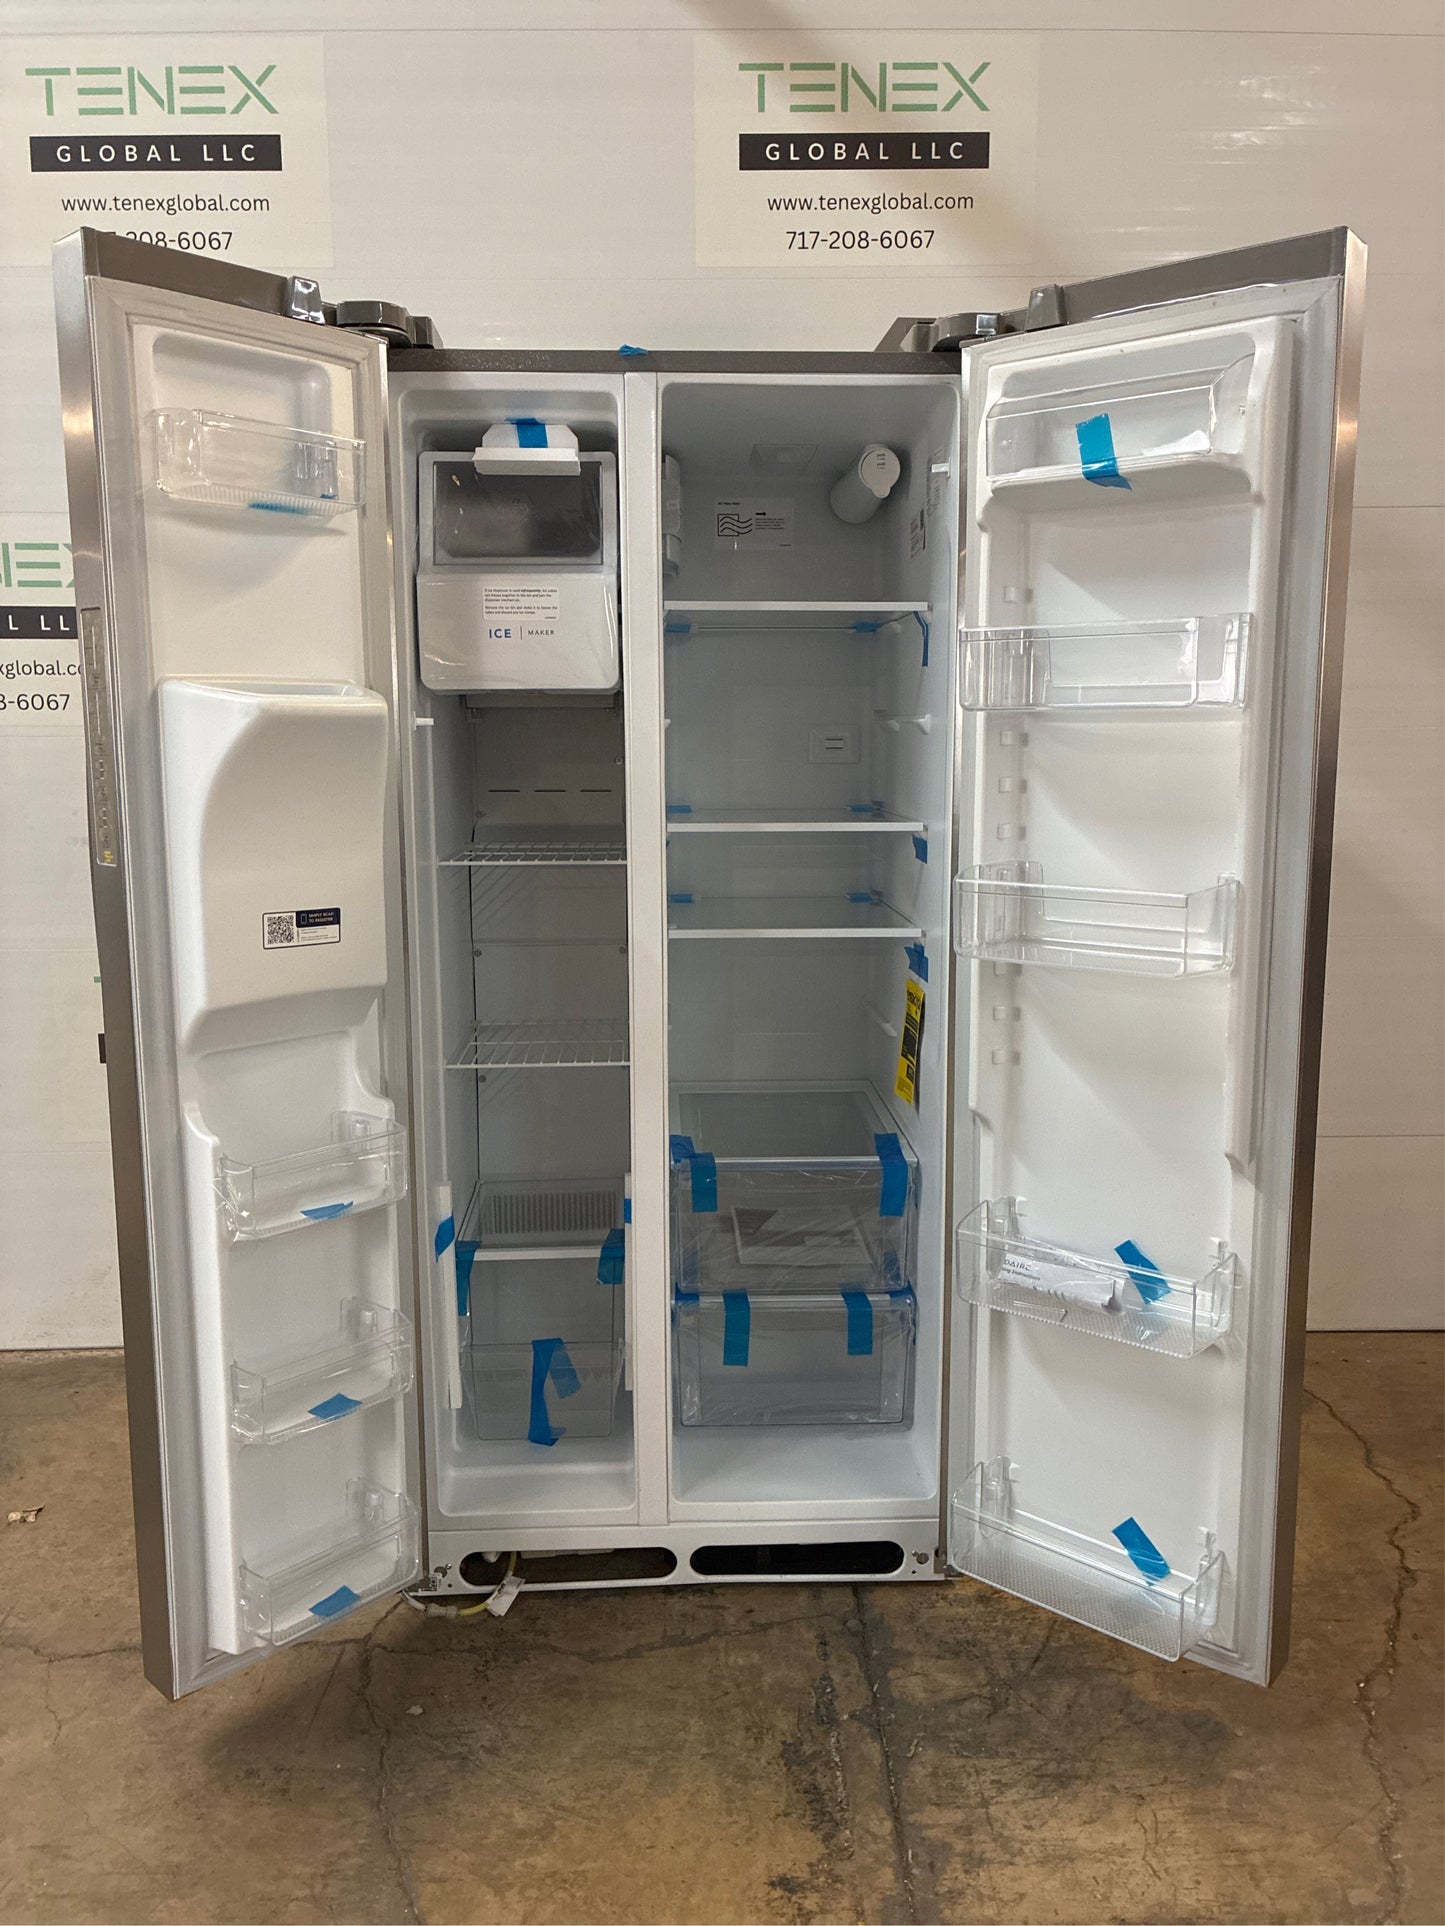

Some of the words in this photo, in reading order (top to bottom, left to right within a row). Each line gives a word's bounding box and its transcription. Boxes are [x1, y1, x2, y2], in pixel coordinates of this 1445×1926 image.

[25, 65, 279, 115] TENEX
[739, 62, 991, 113] TENEX
[56, 145, 181, 162] GLOBAL
[203, 144, 256, 162] LLC
[765, 142, 889, 161] GLOBAL
[911, 141, 963, 159] LLC
[62, 194, 270, 216] www.tenexglobal.com
[767, 193, 974, 215] www.tenexglobal.com
[104, 231, 233, 250] 08-6067
[786, 230, 935, 250] 717-208-6067
[40, 615, 70, 631] LL
[489, 629, 512, 638] ICE
